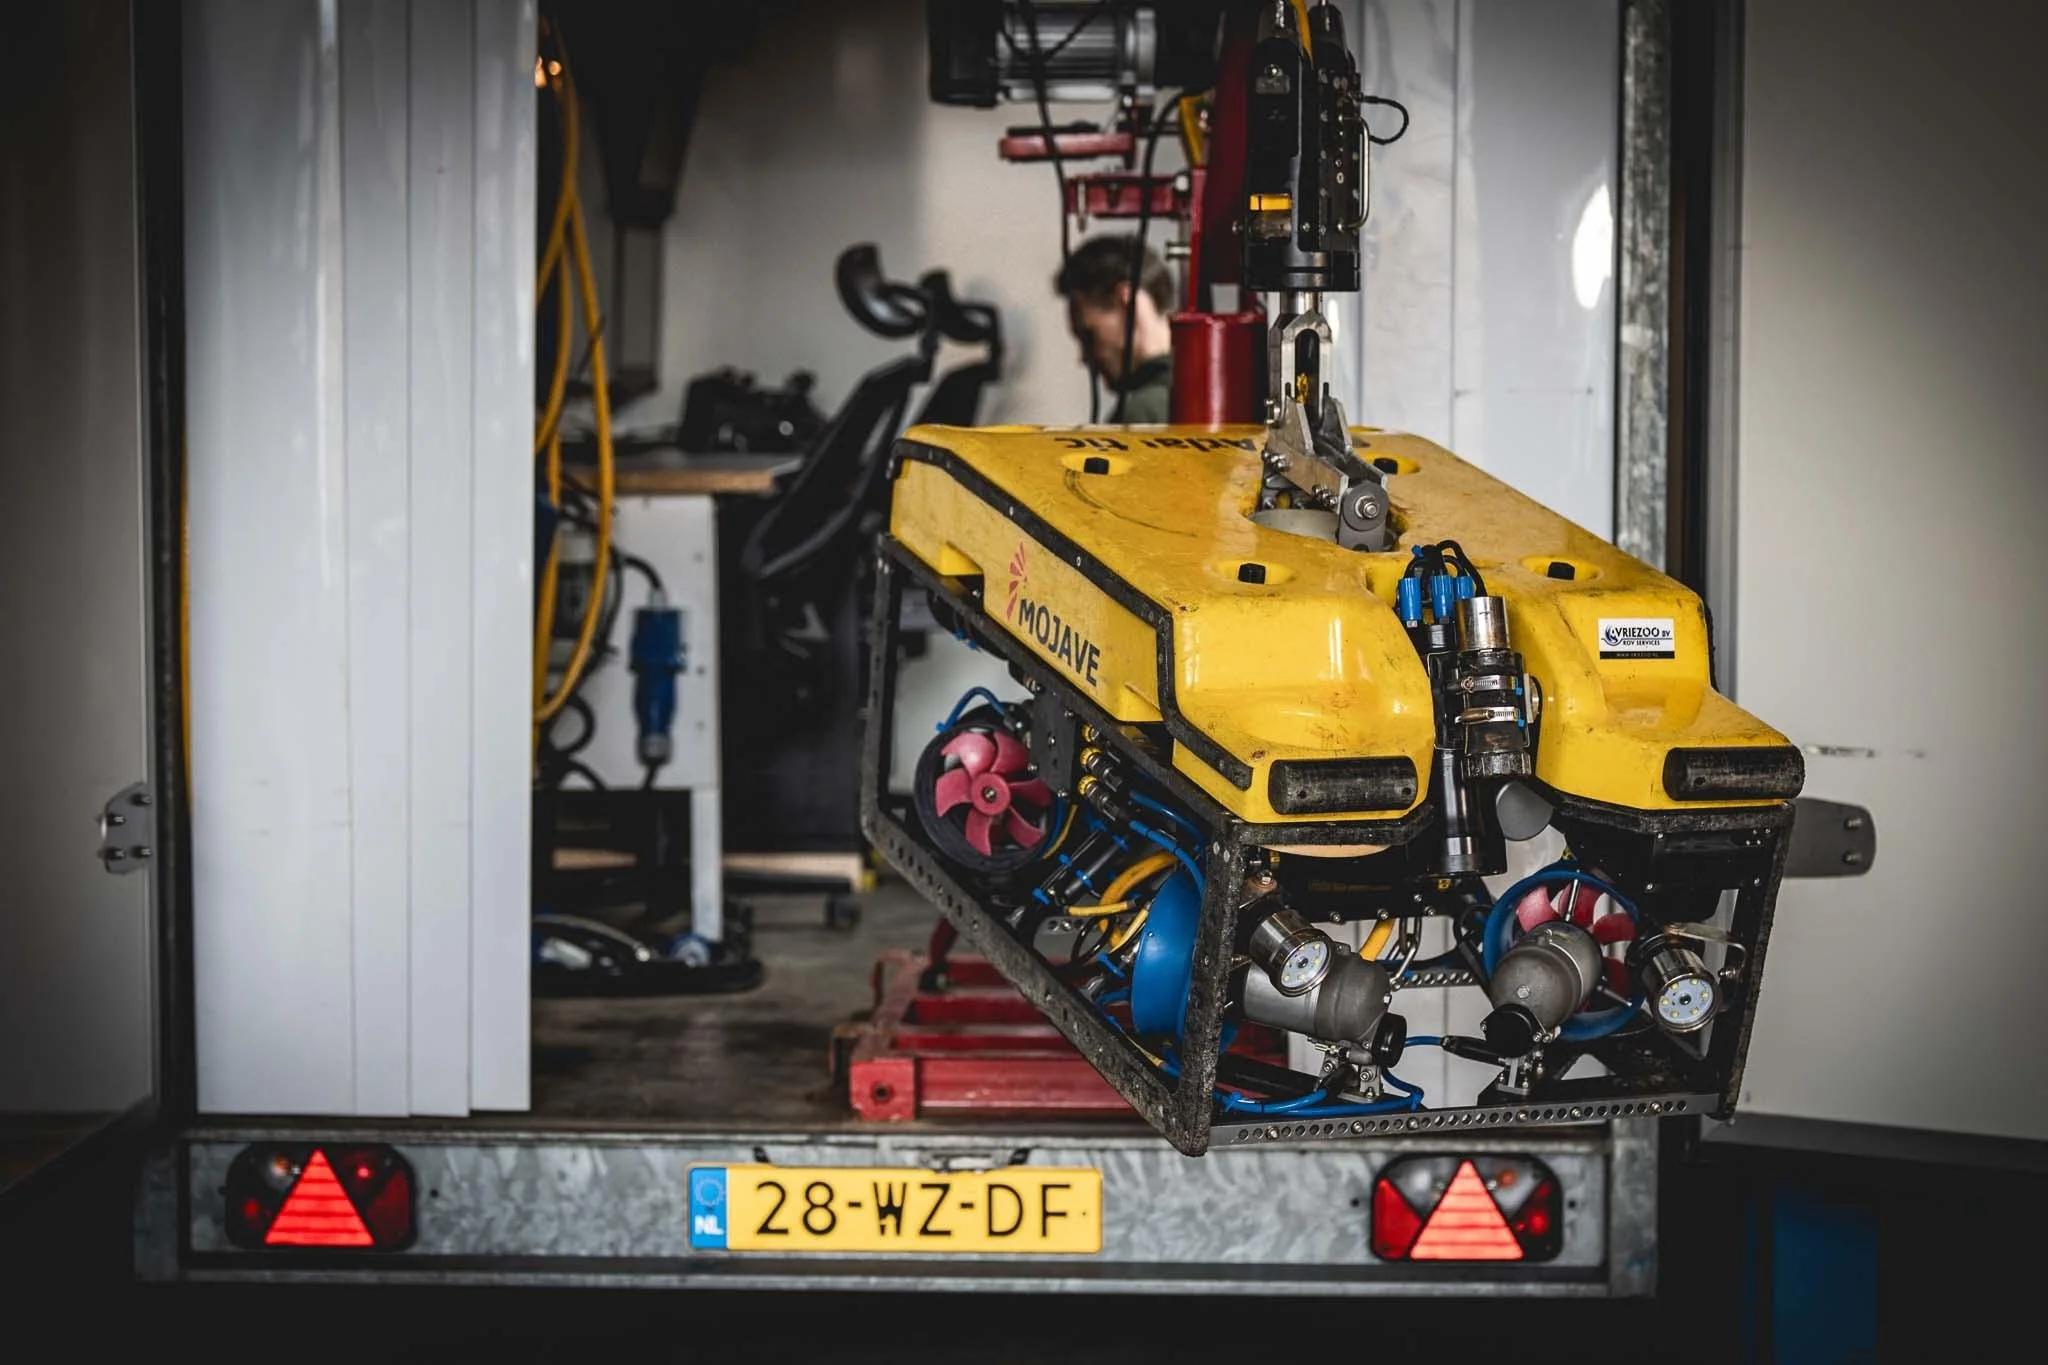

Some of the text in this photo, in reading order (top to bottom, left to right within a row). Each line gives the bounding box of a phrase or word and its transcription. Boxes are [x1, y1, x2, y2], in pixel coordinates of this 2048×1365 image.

[1018, 598, 1100, 687] MOJAVE
[1615, 627, 1660, 637] VRIEZOO
[694, 1214, 723, 1236] NL
[756, 1181, 1071, 1238] 28-WZ-DF
